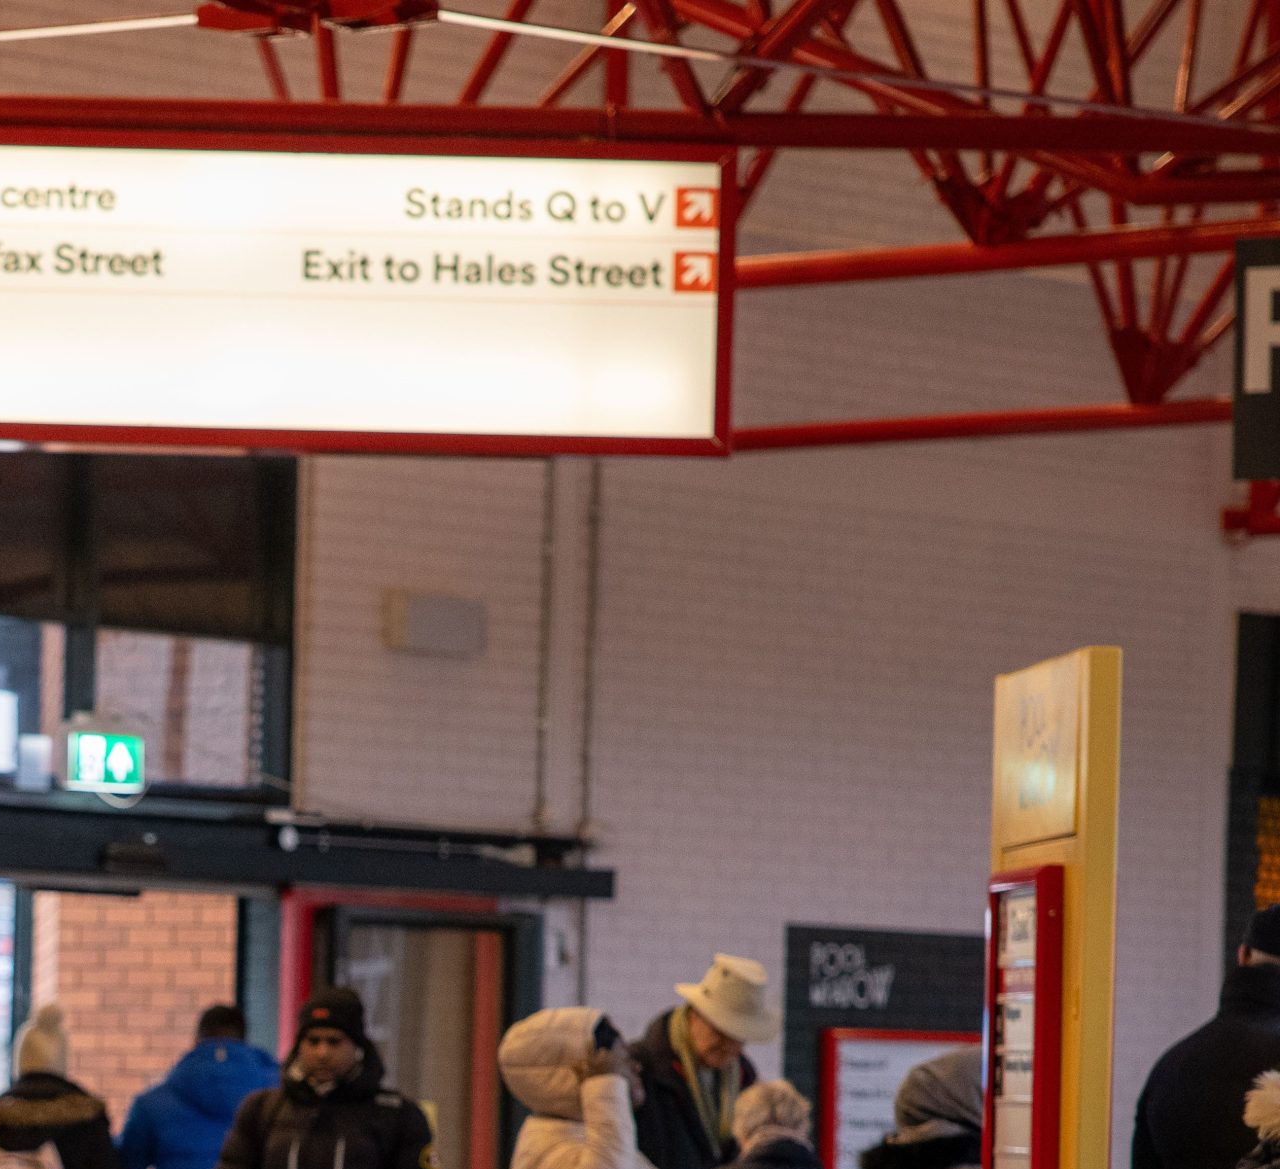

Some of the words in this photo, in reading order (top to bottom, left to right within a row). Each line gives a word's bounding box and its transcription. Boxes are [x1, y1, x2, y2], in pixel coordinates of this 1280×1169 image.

[1, 183, 115, 210] centre
[406, 188, 532, 220] Stands
[547, 191, 576, 222] Q
[590, 197, 625, 223] to
[640, 193, 666, 224] V
[54, 243, 162, 276] Street
[302, 250, 370, 281] Exit
[383, 256, 420, 283] to
[433, 253, 536, 286] Hales
[549, 254, 663, 288] Street
